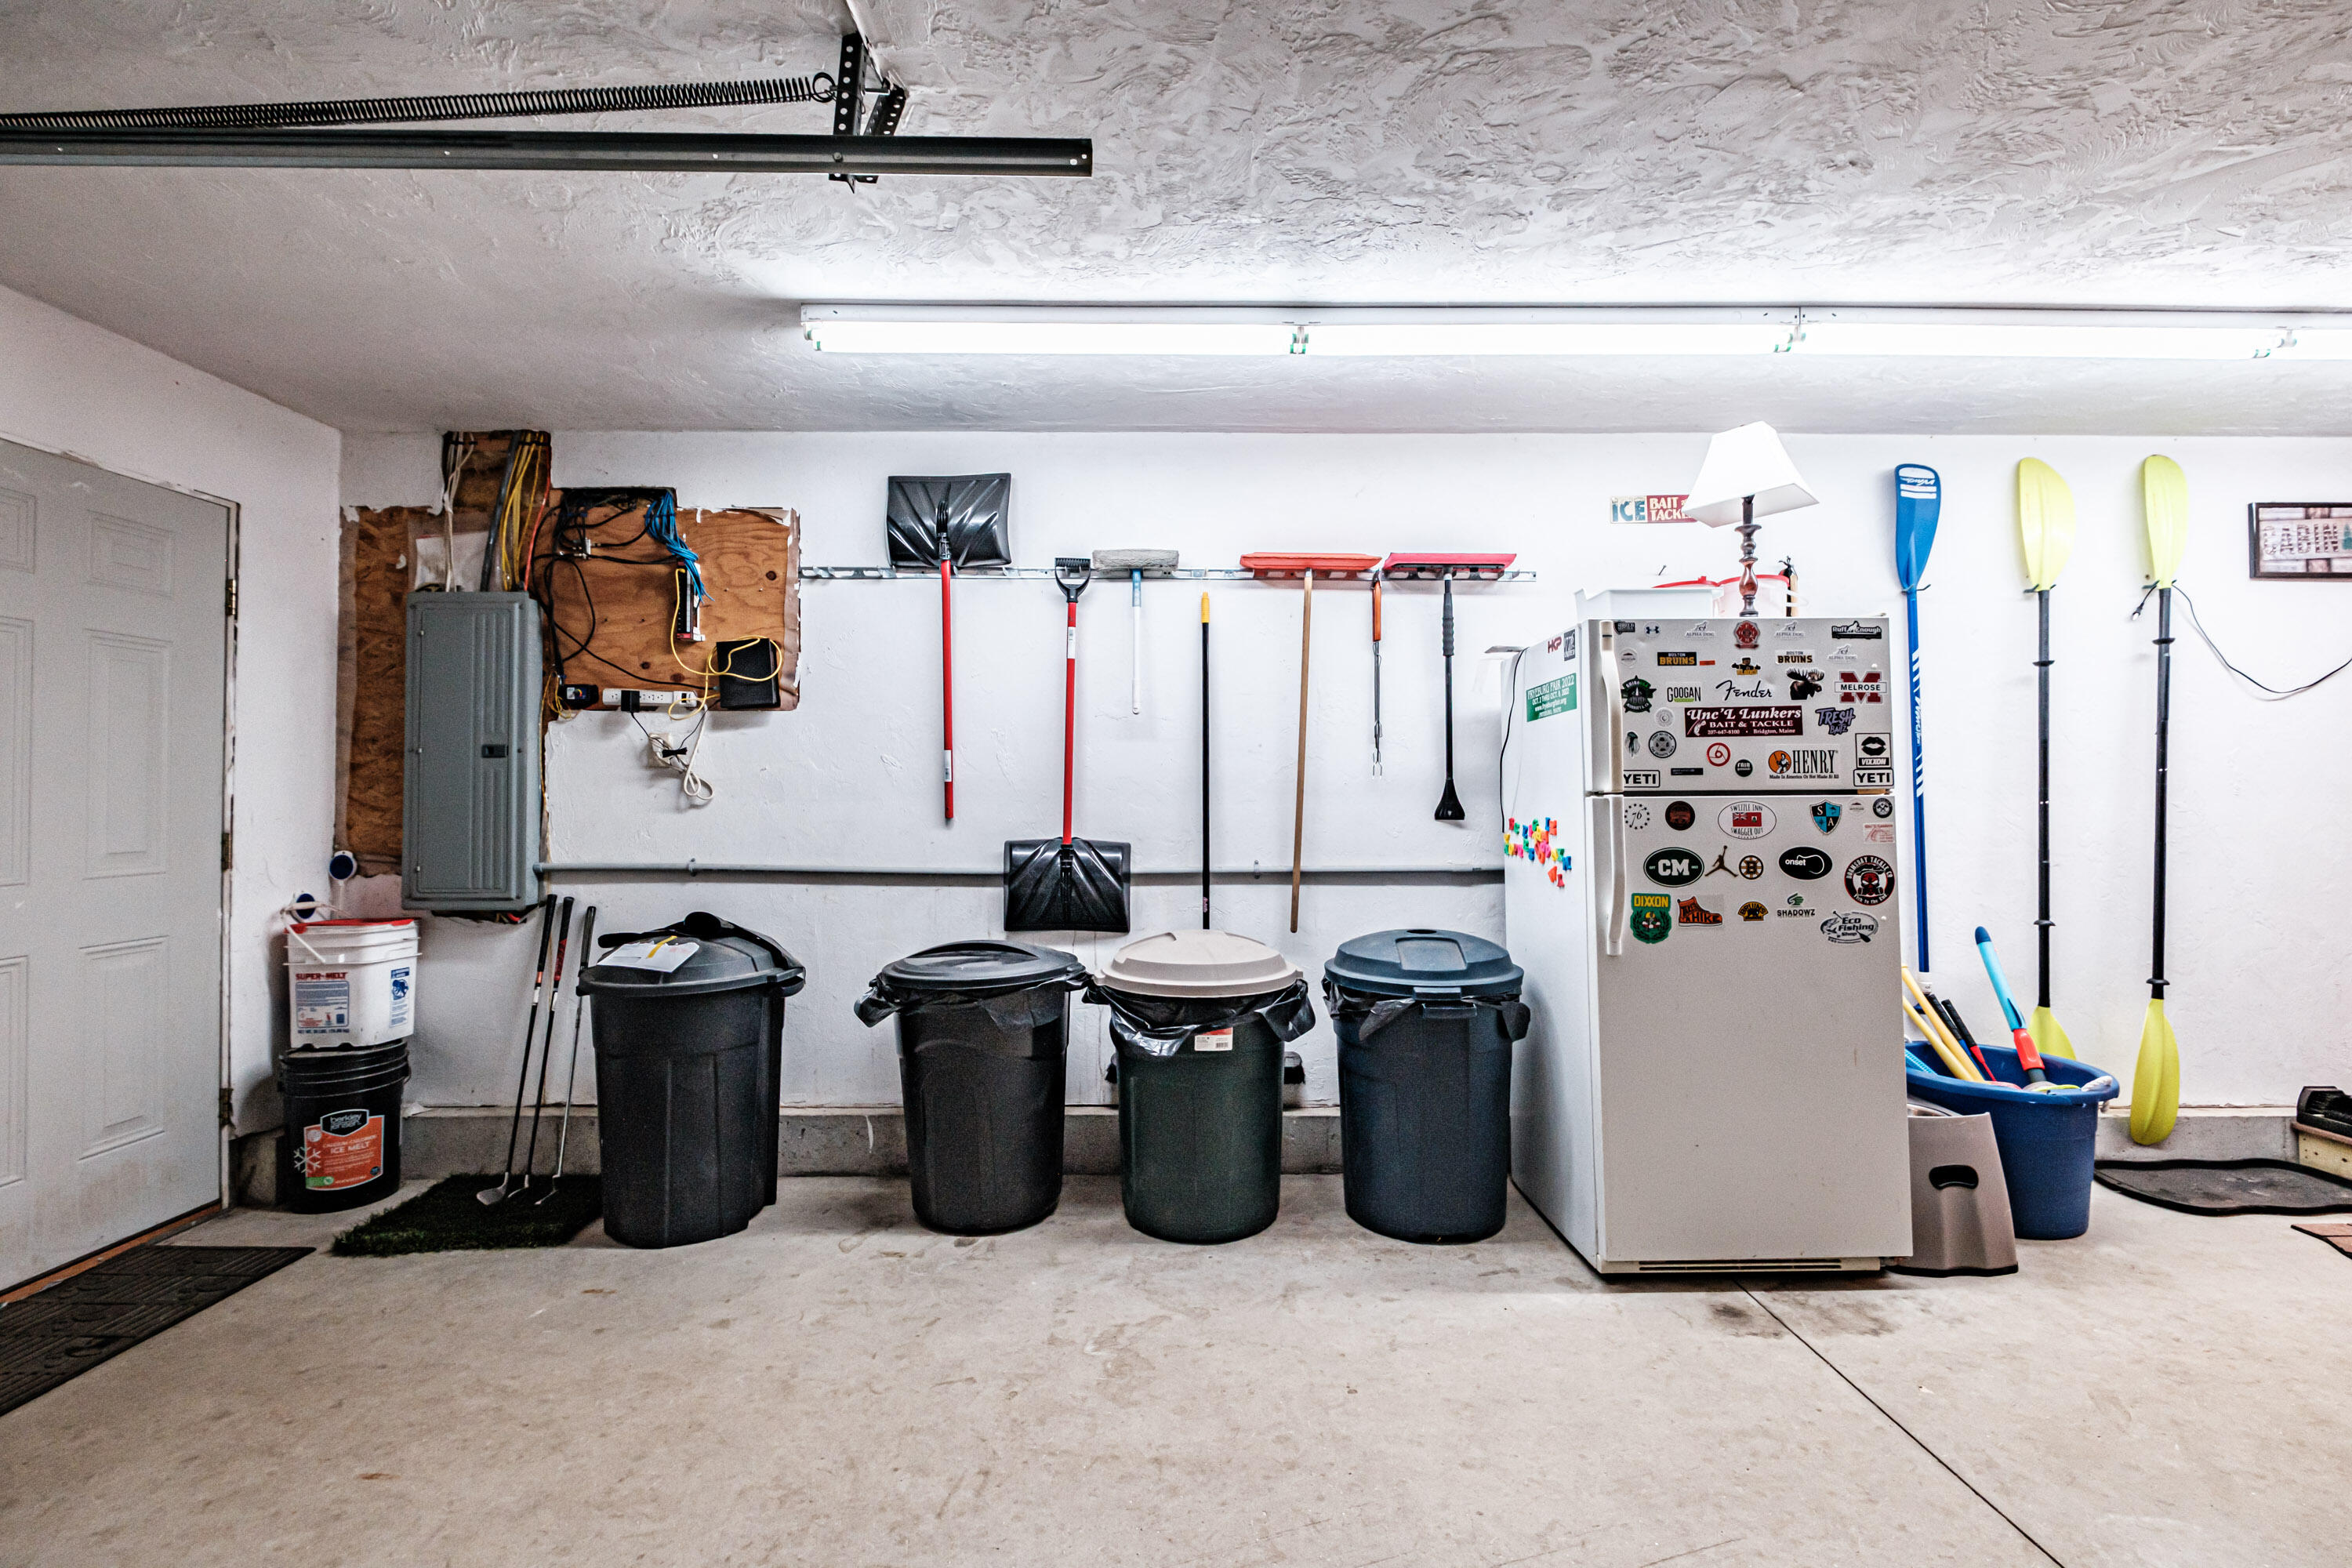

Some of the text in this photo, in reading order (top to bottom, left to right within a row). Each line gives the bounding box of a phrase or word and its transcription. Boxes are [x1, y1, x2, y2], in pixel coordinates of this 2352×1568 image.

[1612, 497, 1646, 522] ICE
[1649, 496, 1679, 510] BAIT
[1659, 657, 1695, 666] BRUINS
[1777, 655, 1813, 664] BRUINS
[1527, 675, 1574, 700] FRYEBURG FAIR 2022
[1715, 680, 1773, 701] Fender
[1667, 687, 1701, 702] GOOGAN
[1686, 708, 1737, 720] Unc'L
[1739, 706, 1802, 720] Lunkers
[1792, 750, 1835, 774] HENRY
[1624, 774, 1657, 784] YETI
[1857, 773, 1890, 783] YETI
[1817, 806, 1824, 815] S
[1828, 817, 1835, 826] A
[1730, 827, 1753, 836] SWAGGER
[1657, 858, 1690, 877] CM
[1785, 858, 1806, 866] onset
[1846, 856, 1867, 879] DOOMSDAY
[1870, 856, 1889, 871] TACKLE
[1634, 895, 1669, 908] DIXXON
[1739, 902, 1766, 915] BRUINS
[1692, 910, 1721, 923] HIKE
[295, 972, 348, 981] SUPER-MELT
[330, 1113, 362, 1123] berkley
[347, 1141, 370, 1151] MELT
